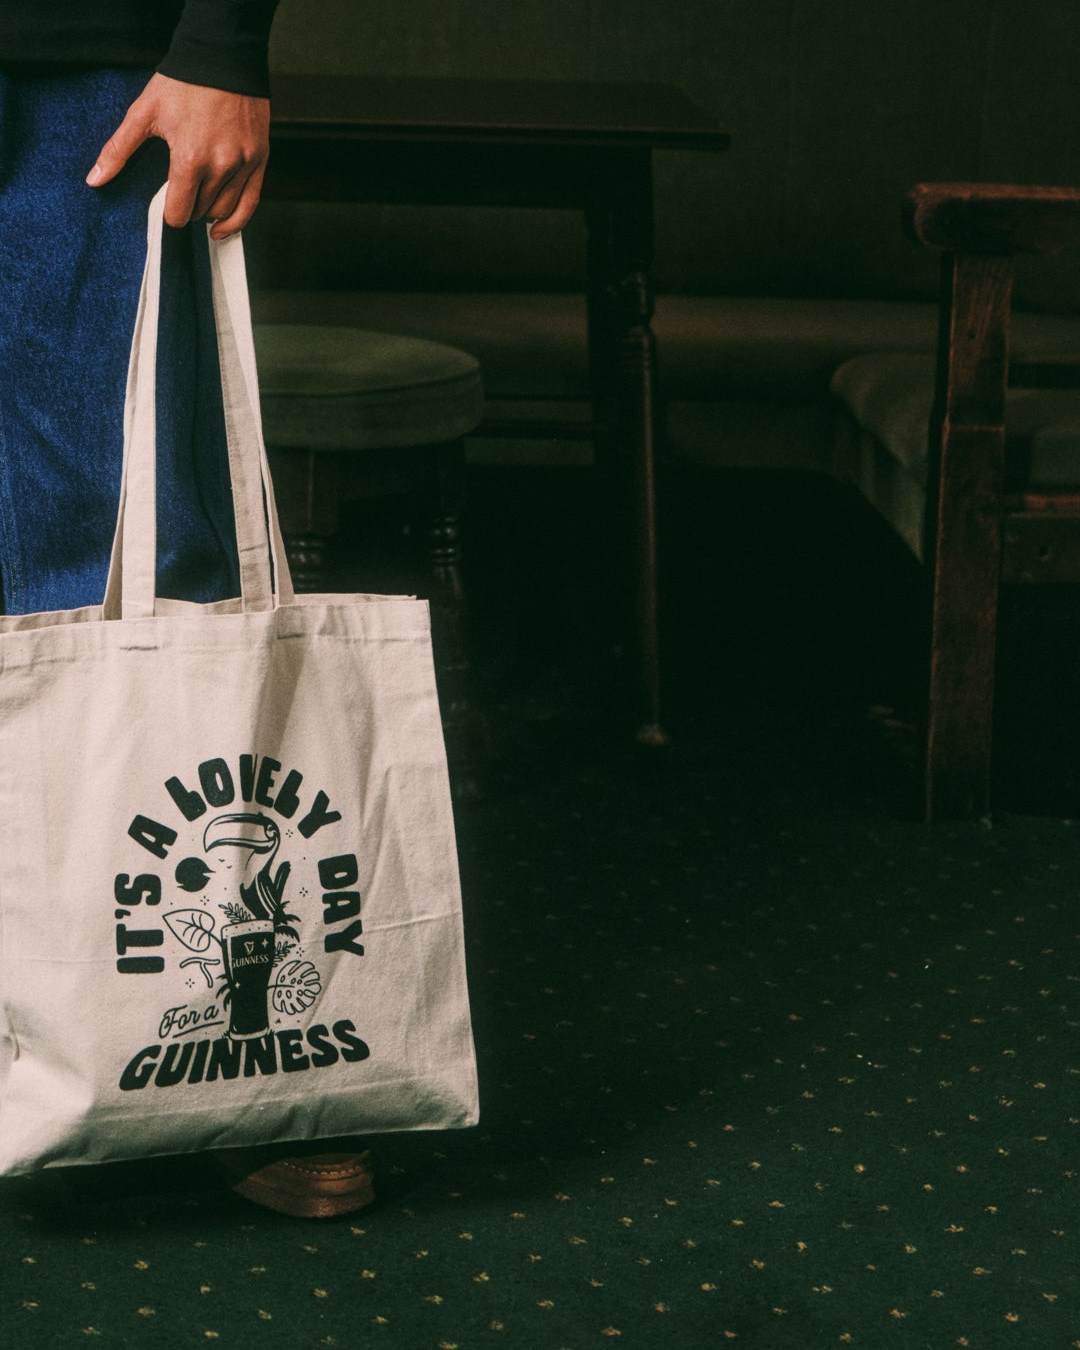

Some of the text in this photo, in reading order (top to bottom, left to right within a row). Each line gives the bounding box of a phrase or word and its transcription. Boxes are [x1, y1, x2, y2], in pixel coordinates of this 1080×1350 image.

[114, 753, 365, 974] IT'S A LOVELY DAY
[232, 954, 269, 968] GUINNESS
[159, 1004, 220, 1039] For a
[119, 1019, 371, 1091] GUINNESS
